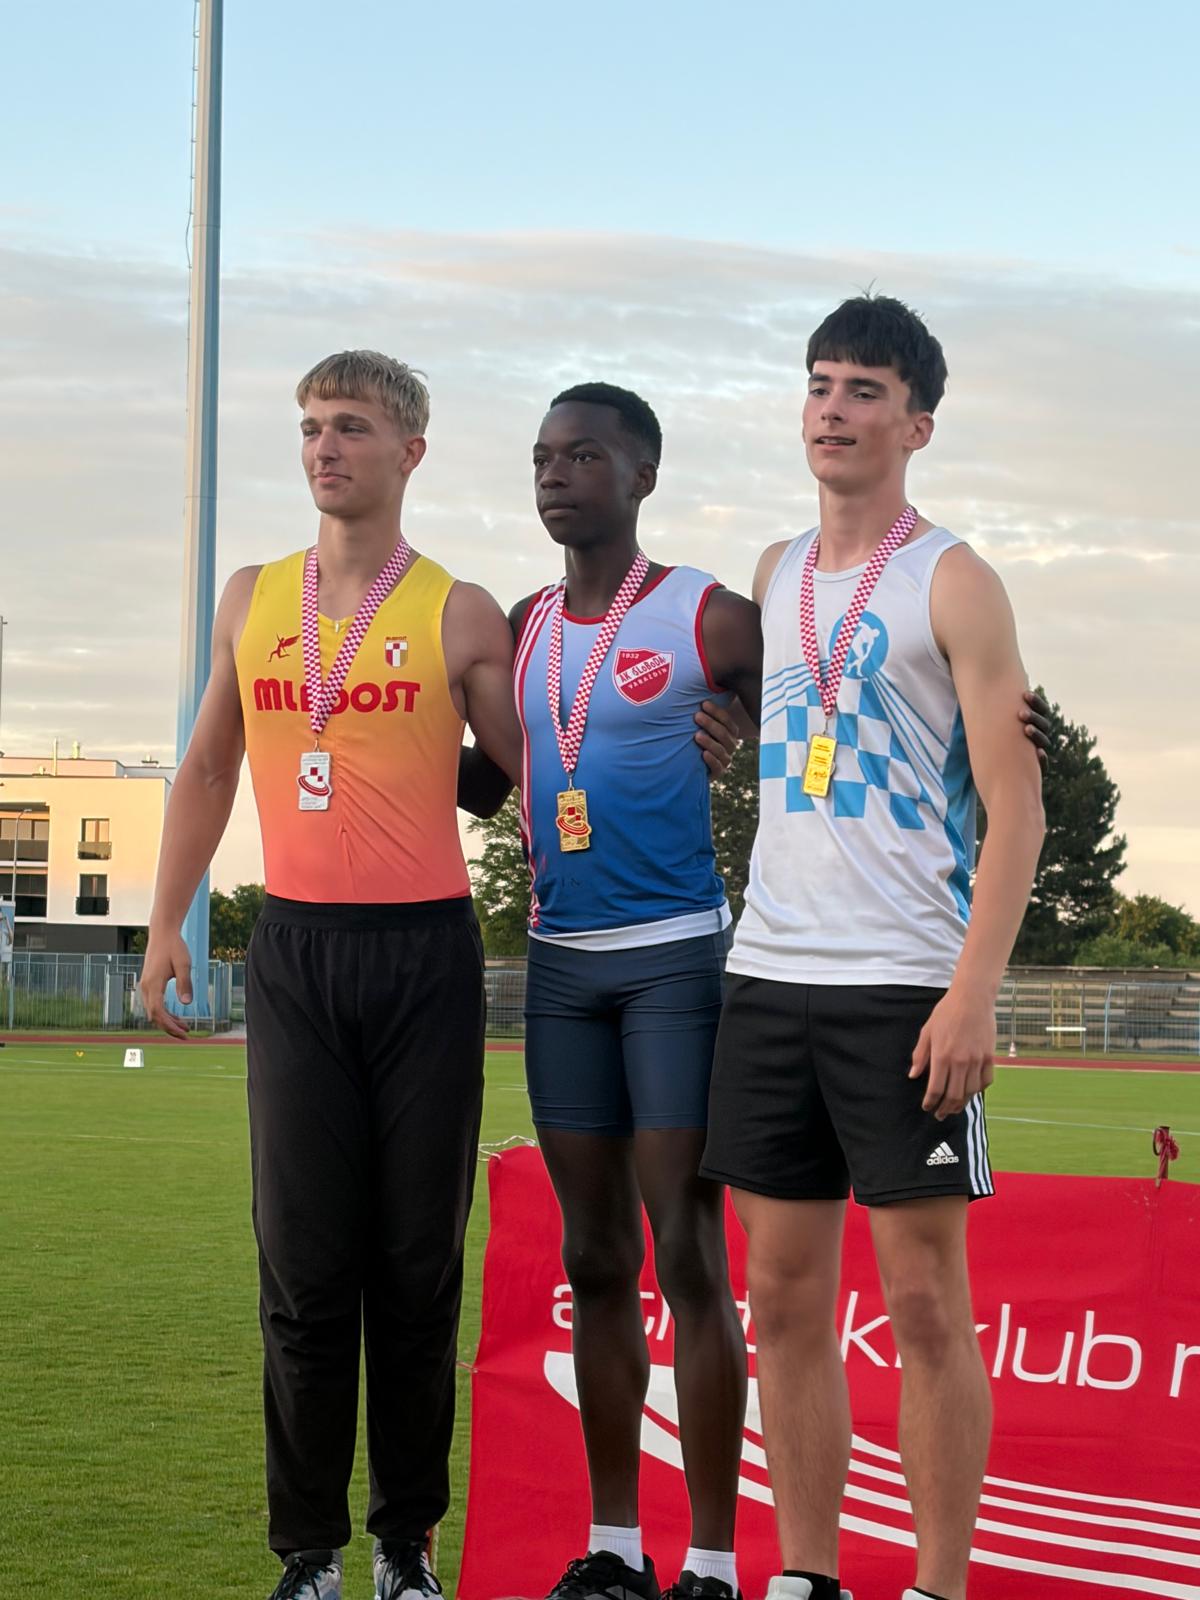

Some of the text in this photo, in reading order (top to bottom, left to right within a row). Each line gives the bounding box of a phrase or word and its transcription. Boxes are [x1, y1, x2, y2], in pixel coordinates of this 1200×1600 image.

[619, 671, 632, 683] AK
[926, 1155, 960, 1166] adidas
[974, 1303, 1142, 1391] lub
